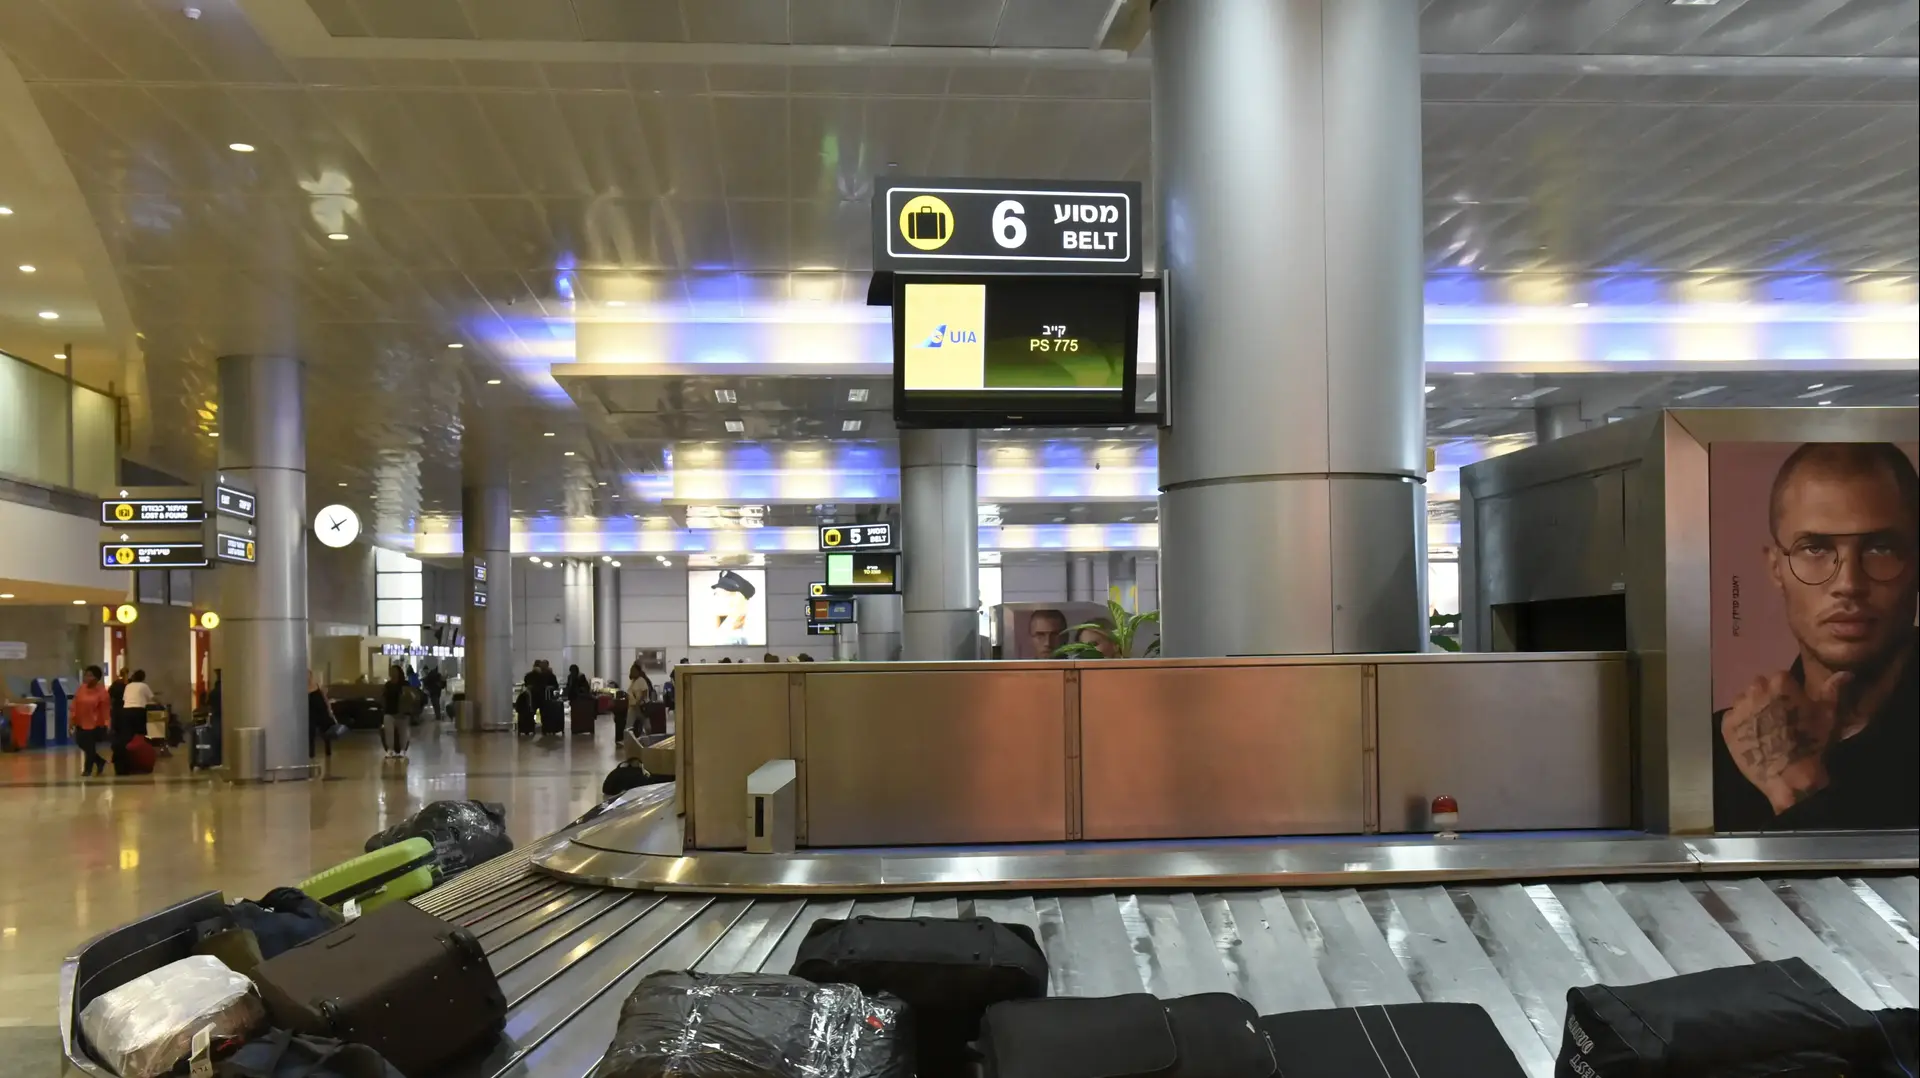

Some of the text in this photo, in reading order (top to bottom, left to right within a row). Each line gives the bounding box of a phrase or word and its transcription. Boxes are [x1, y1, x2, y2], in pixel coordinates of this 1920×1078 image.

[1053, 204, 1119, 224] מסוע
[992, 200, 1027, 249] 6
[1062, 231, 1118, 250] BELT
[950, 331, 977, 343] UIA
[1042, 325, 1067, 338] קייב
[1030, 339, 1079, 351] PS 775
[850, 528, 861, 544] 5
[870, 535, 887, 543] BELT
[1569, 1053, 1603, 1078] EST
